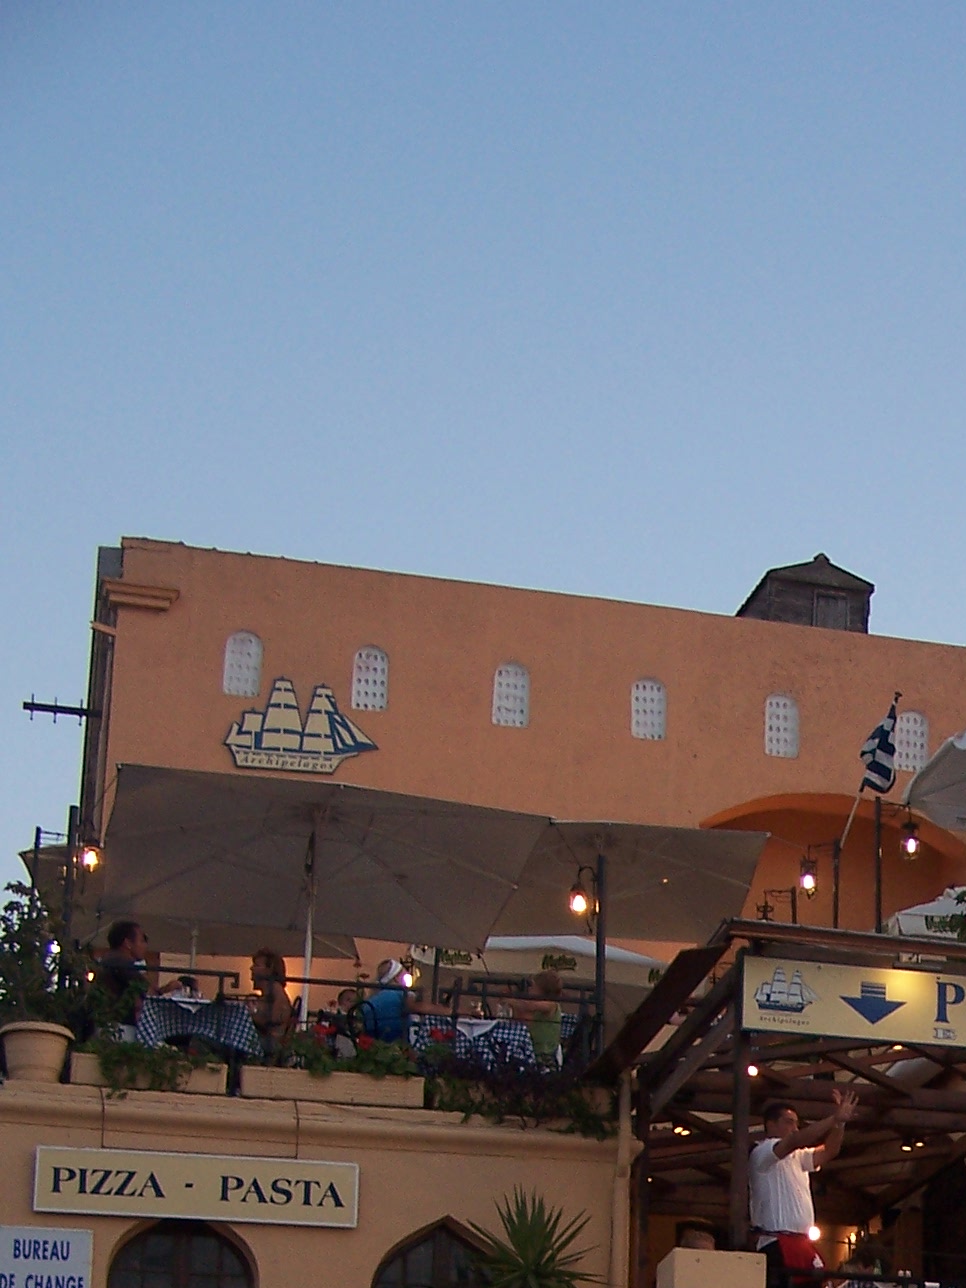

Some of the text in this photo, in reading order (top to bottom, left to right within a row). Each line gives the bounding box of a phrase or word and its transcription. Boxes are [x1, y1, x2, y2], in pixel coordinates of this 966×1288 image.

[239, 755, 335, 770] Archipelagos
[51, 1165, 166, 1200] PIZZA
[219, 1174, 345, 1210] PASTA
[13, 1238, 71, 1262] BUREAU
